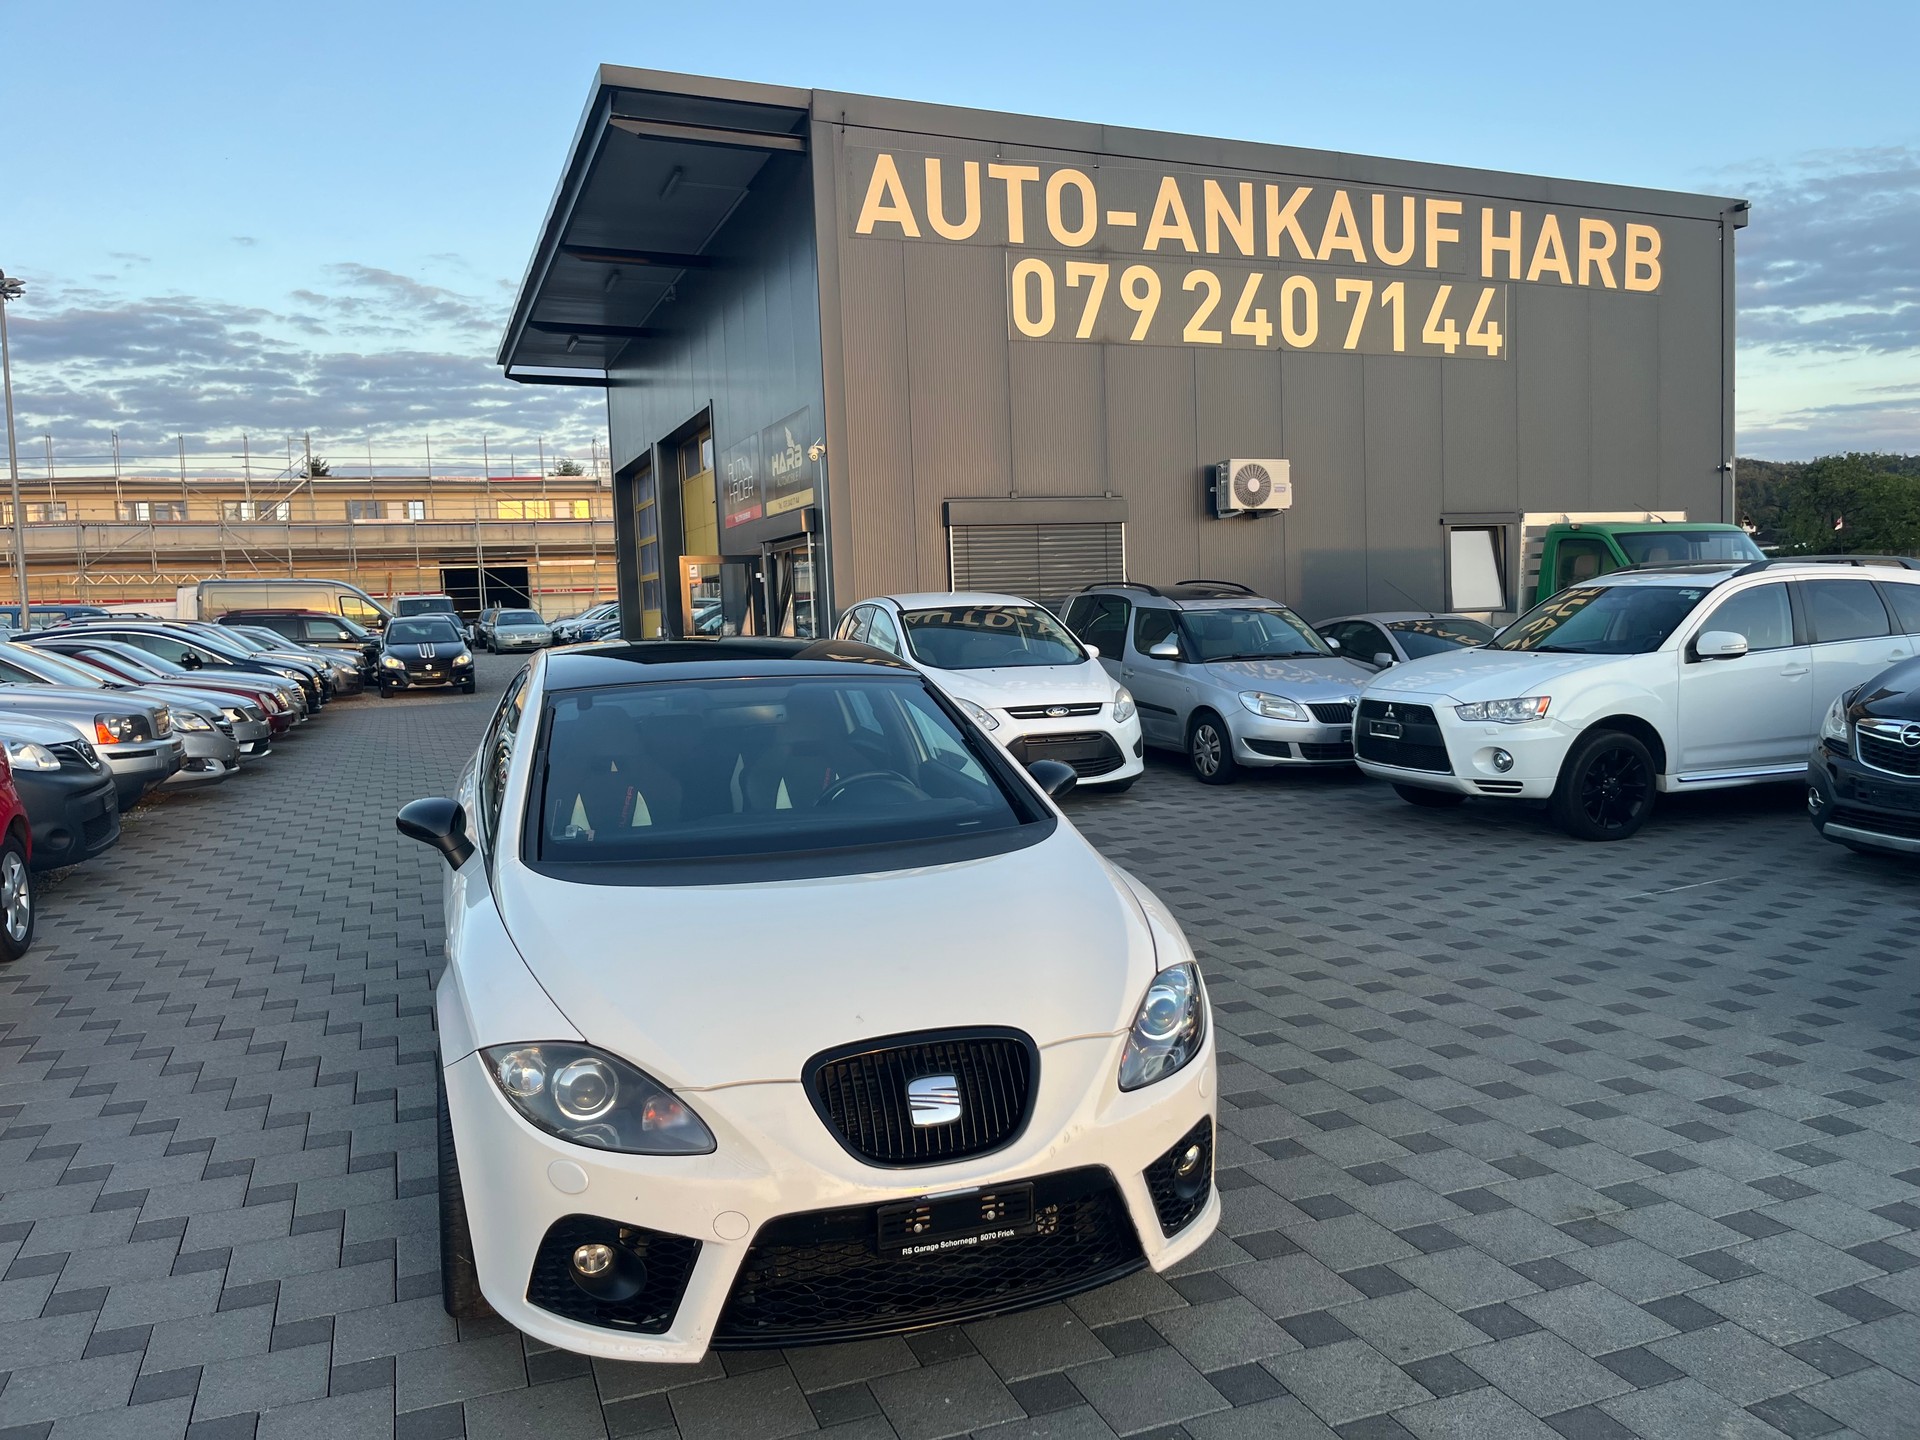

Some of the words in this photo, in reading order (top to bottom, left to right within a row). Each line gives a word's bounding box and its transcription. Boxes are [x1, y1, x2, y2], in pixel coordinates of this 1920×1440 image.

[856, 154, 1463, 268] AUTO-ANKAUF
[1481, 207, 1662, 292] HARB
[1012, 258, 1162, 341] 079
[1183, 269, 1319, 348] 240
[771, 444, 803, 477] HARB
[902, 1247, 913, 1256] RS
[913, 1243, 940, 1254] Garage
[997, 1229, 1015, 1239] Frick
